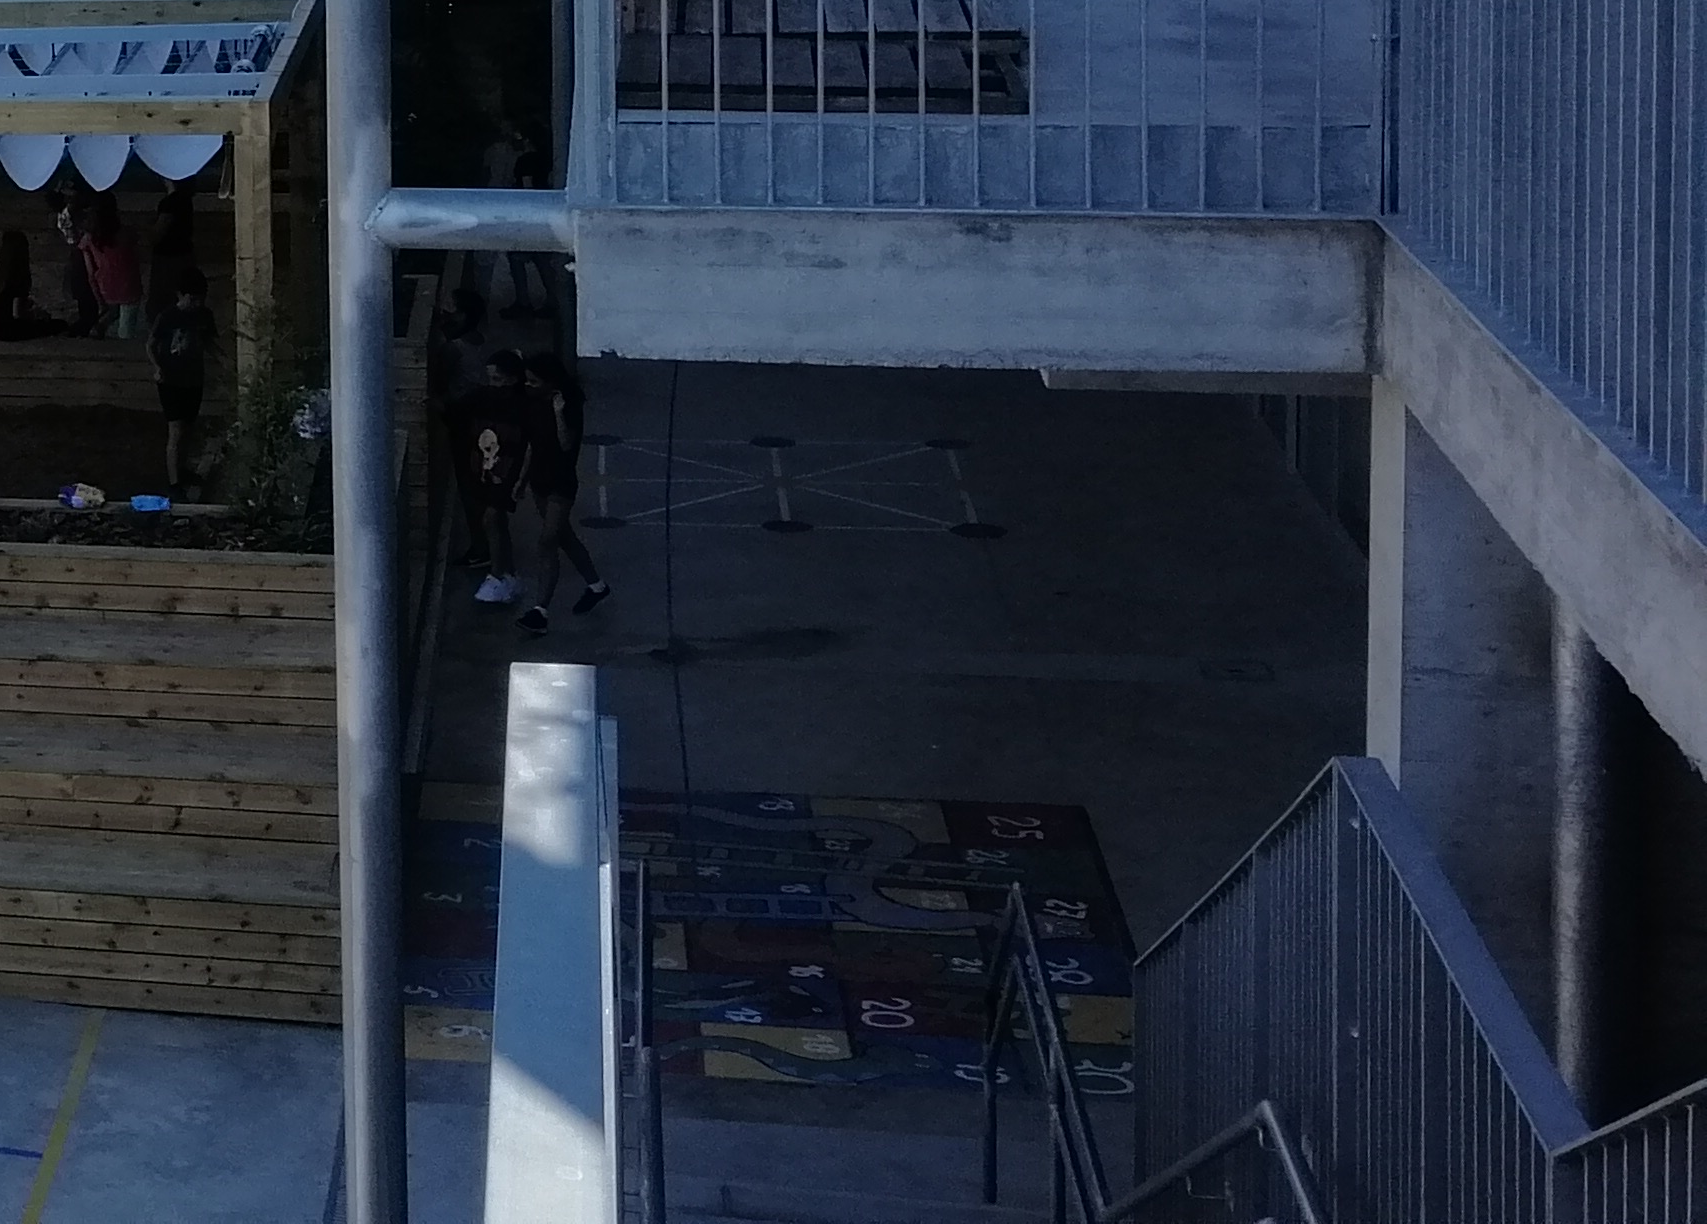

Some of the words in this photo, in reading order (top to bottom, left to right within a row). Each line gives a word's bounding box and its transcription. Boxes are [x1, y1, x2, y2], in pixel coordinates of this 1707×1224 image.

[988, 816, 1044, 840] 25
[1043, 898, 1089, 920] 27
[860, 997, 915, 1029] 20
